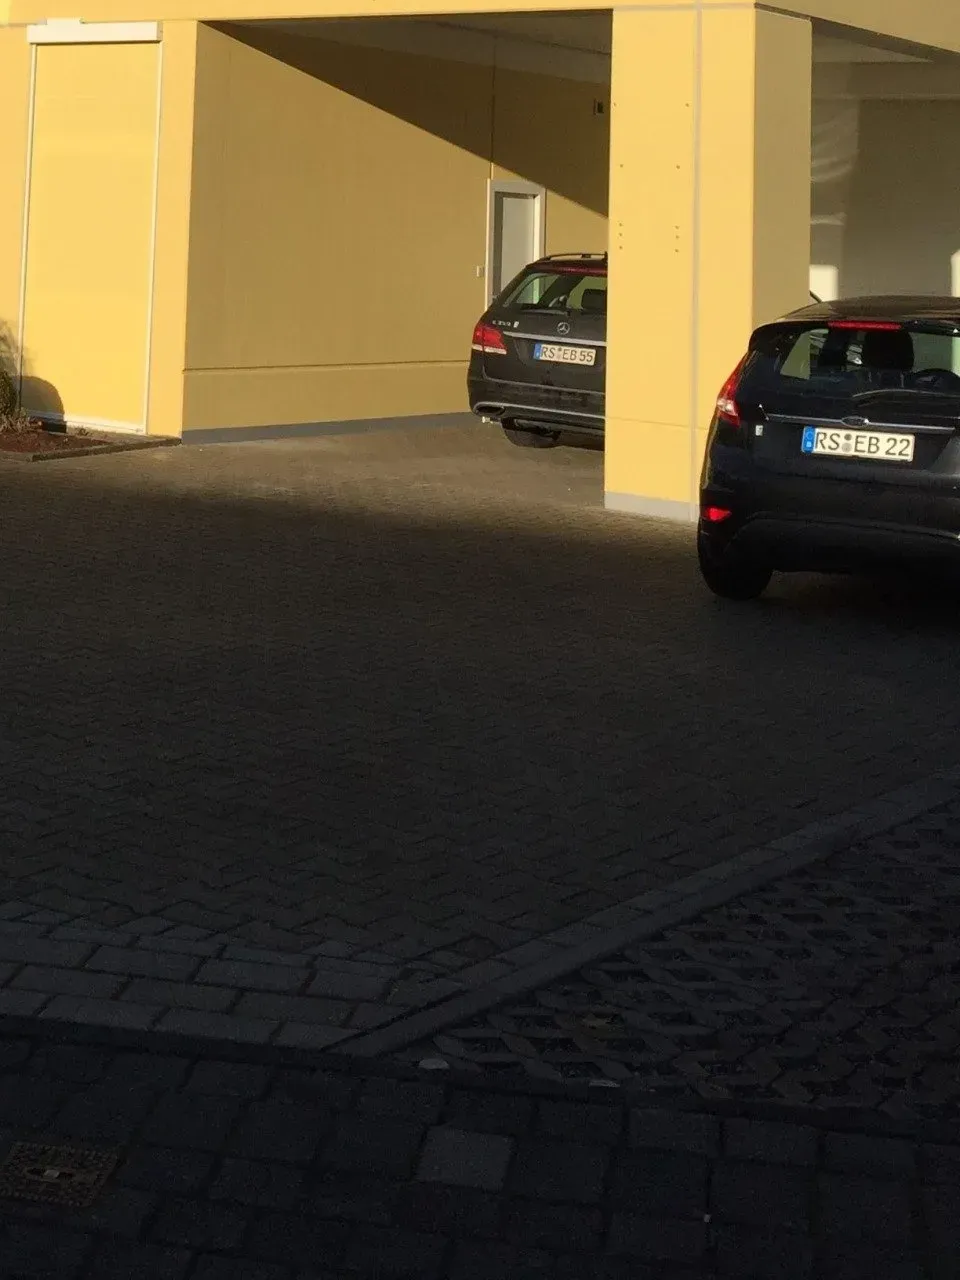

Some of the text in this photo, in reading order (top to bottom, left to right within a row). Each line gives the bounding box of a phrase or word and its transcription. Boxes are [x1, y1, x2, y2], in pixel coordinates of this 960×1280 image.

[579, 350, 594, 363] 55
[815, 432, 911, 456] RS EB 22
